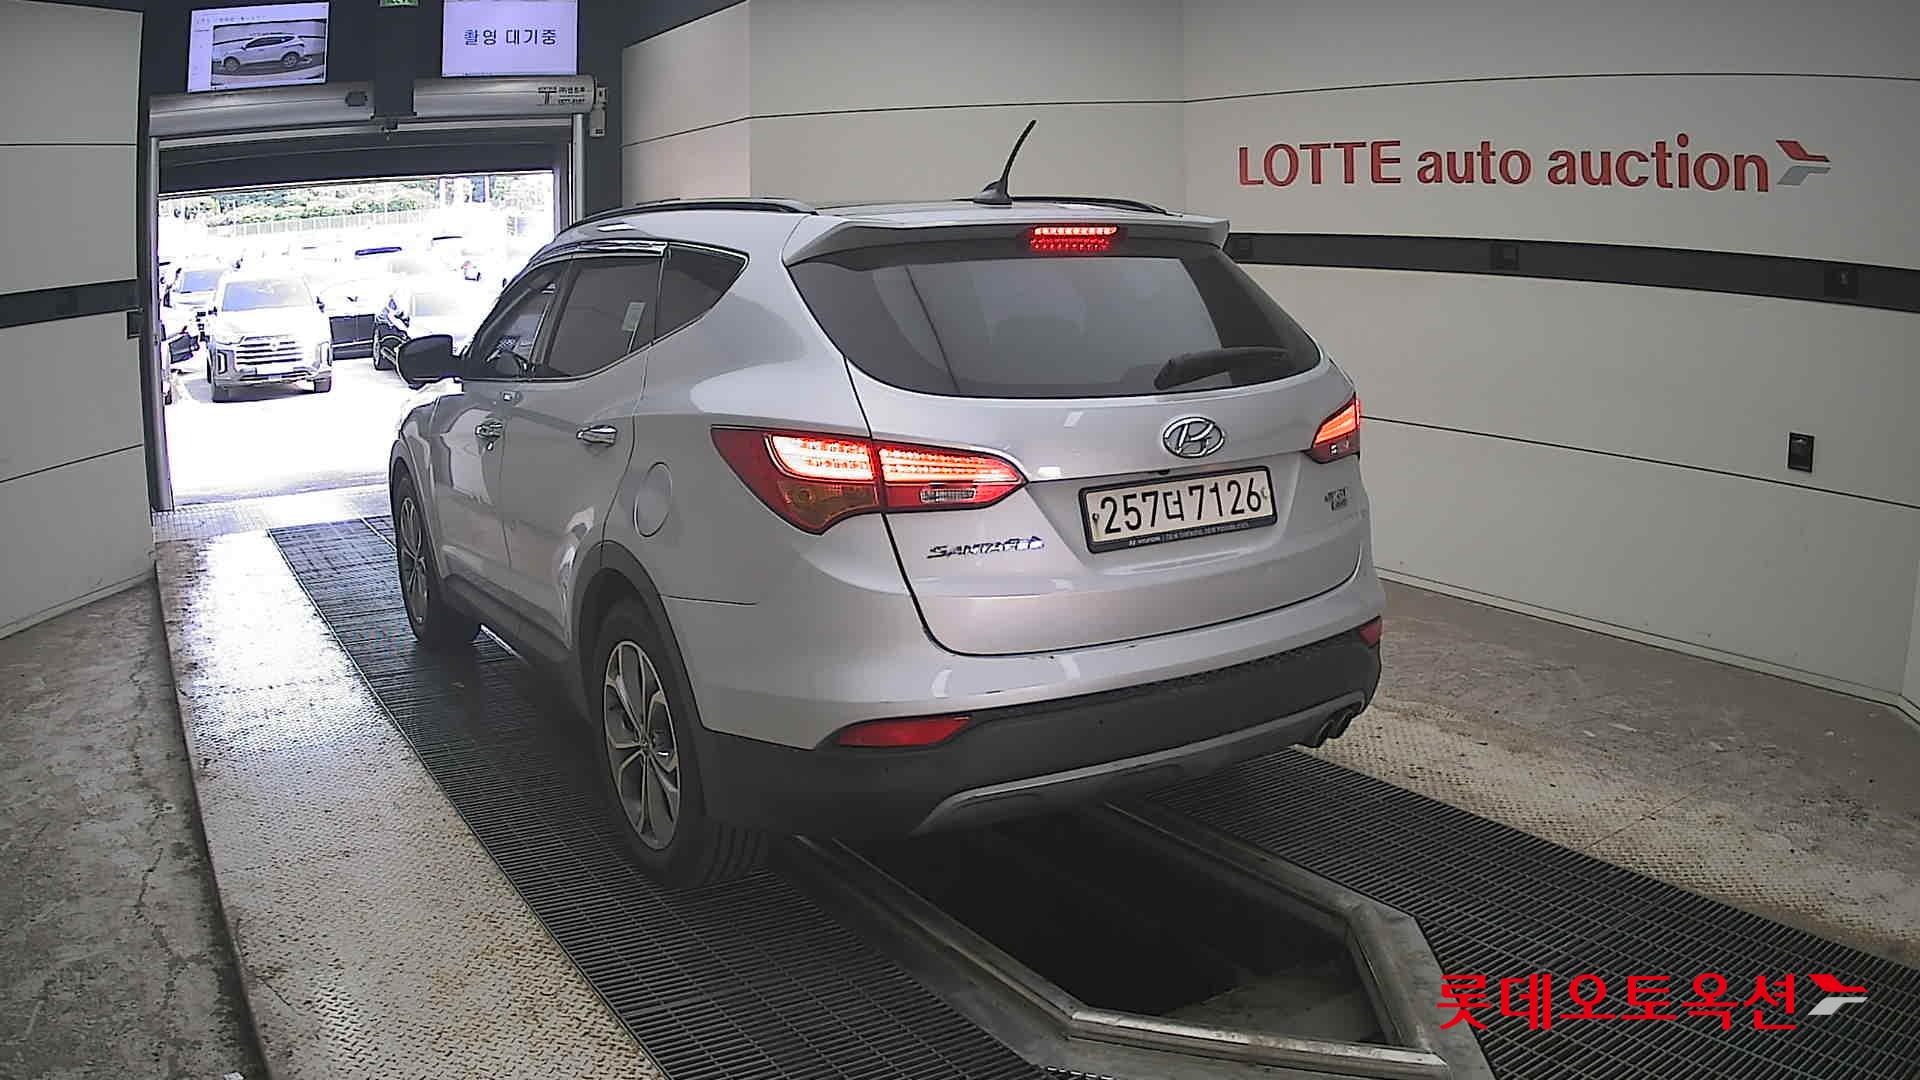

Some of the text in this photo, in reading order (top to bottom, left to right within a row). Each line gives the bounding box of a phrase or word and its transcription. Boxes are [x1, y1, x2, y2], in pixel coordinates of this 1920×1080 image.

[463, 28, 557, 46] 촬영 대기중
[1239, 134, 1769, 193] LOTTE auto auction
